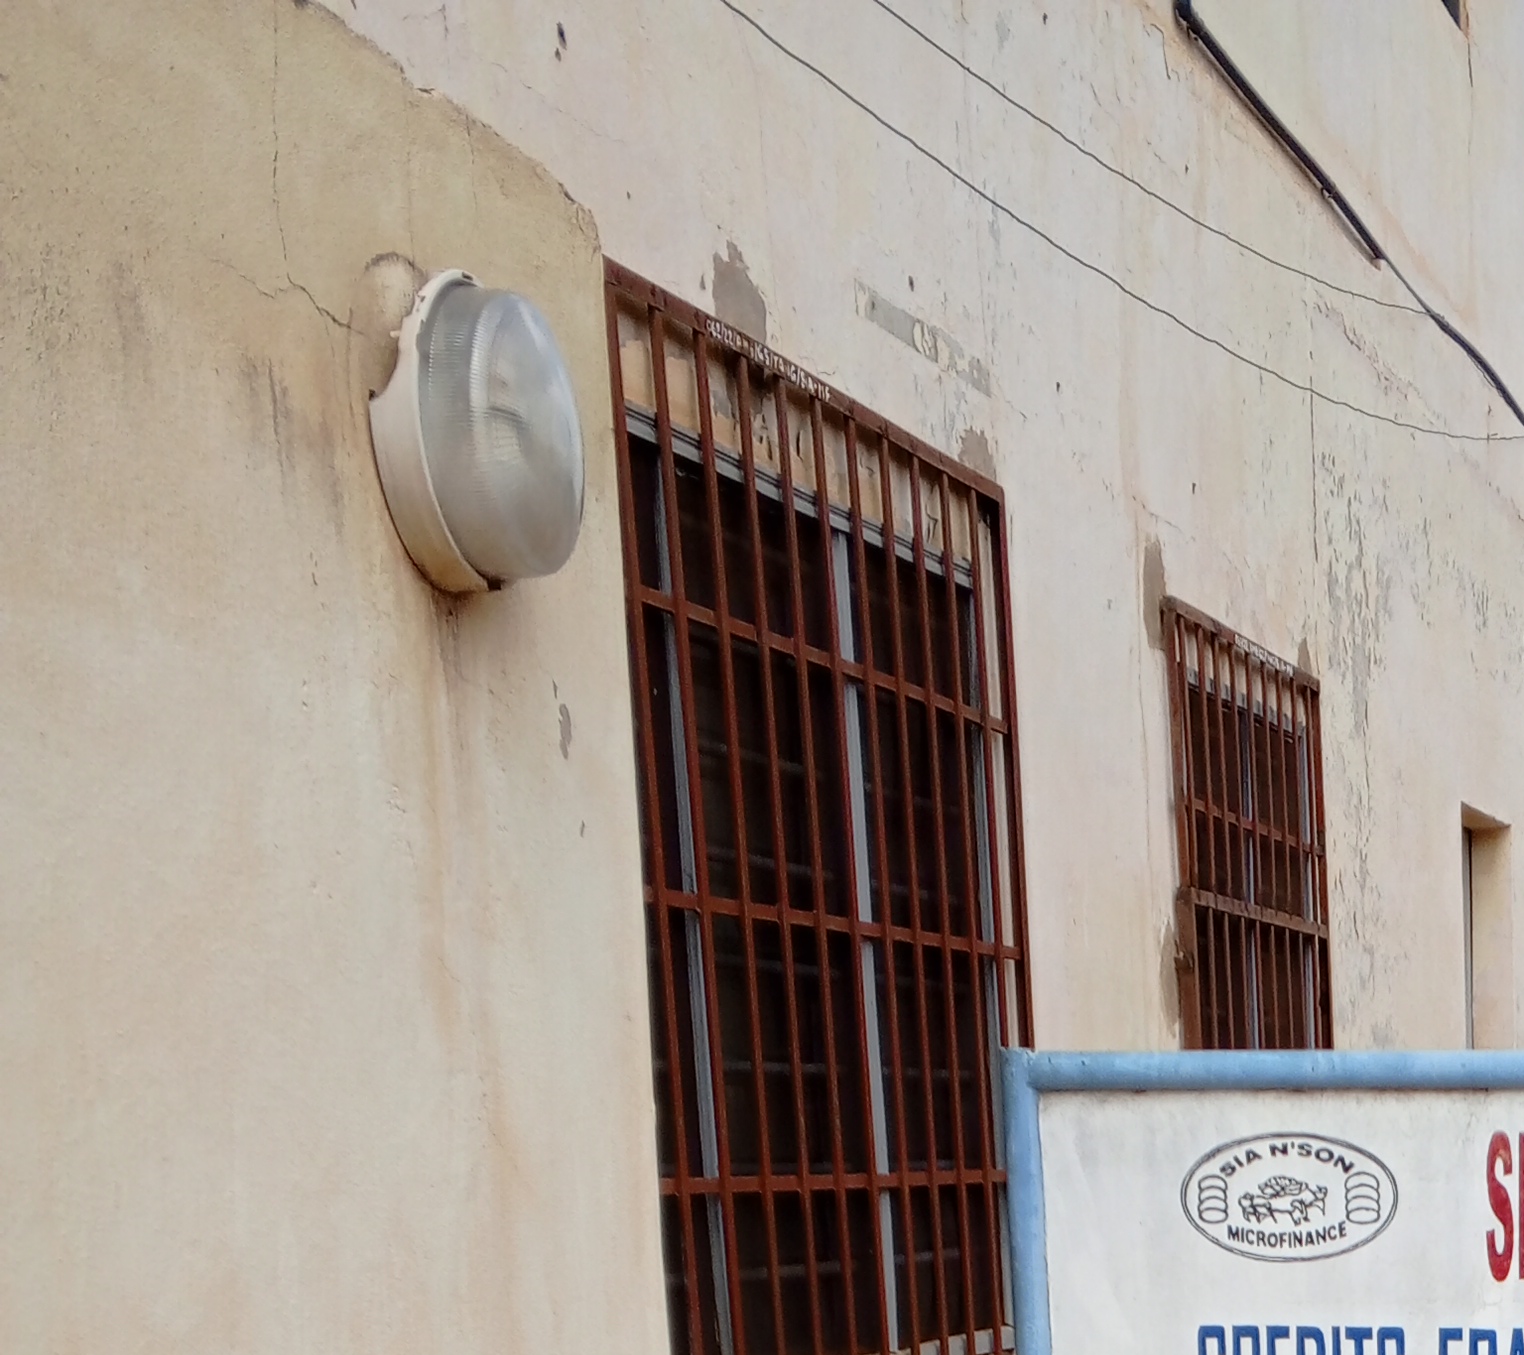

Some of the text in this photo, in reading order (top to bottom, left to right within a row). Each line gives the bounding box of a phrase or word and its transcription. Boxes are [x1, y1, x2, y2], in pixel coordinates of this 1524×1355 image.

[1219, 1141, 1356, 1178] SIA N'SON
[1226, 1219, 1348, 1249] MICROFINANCE
